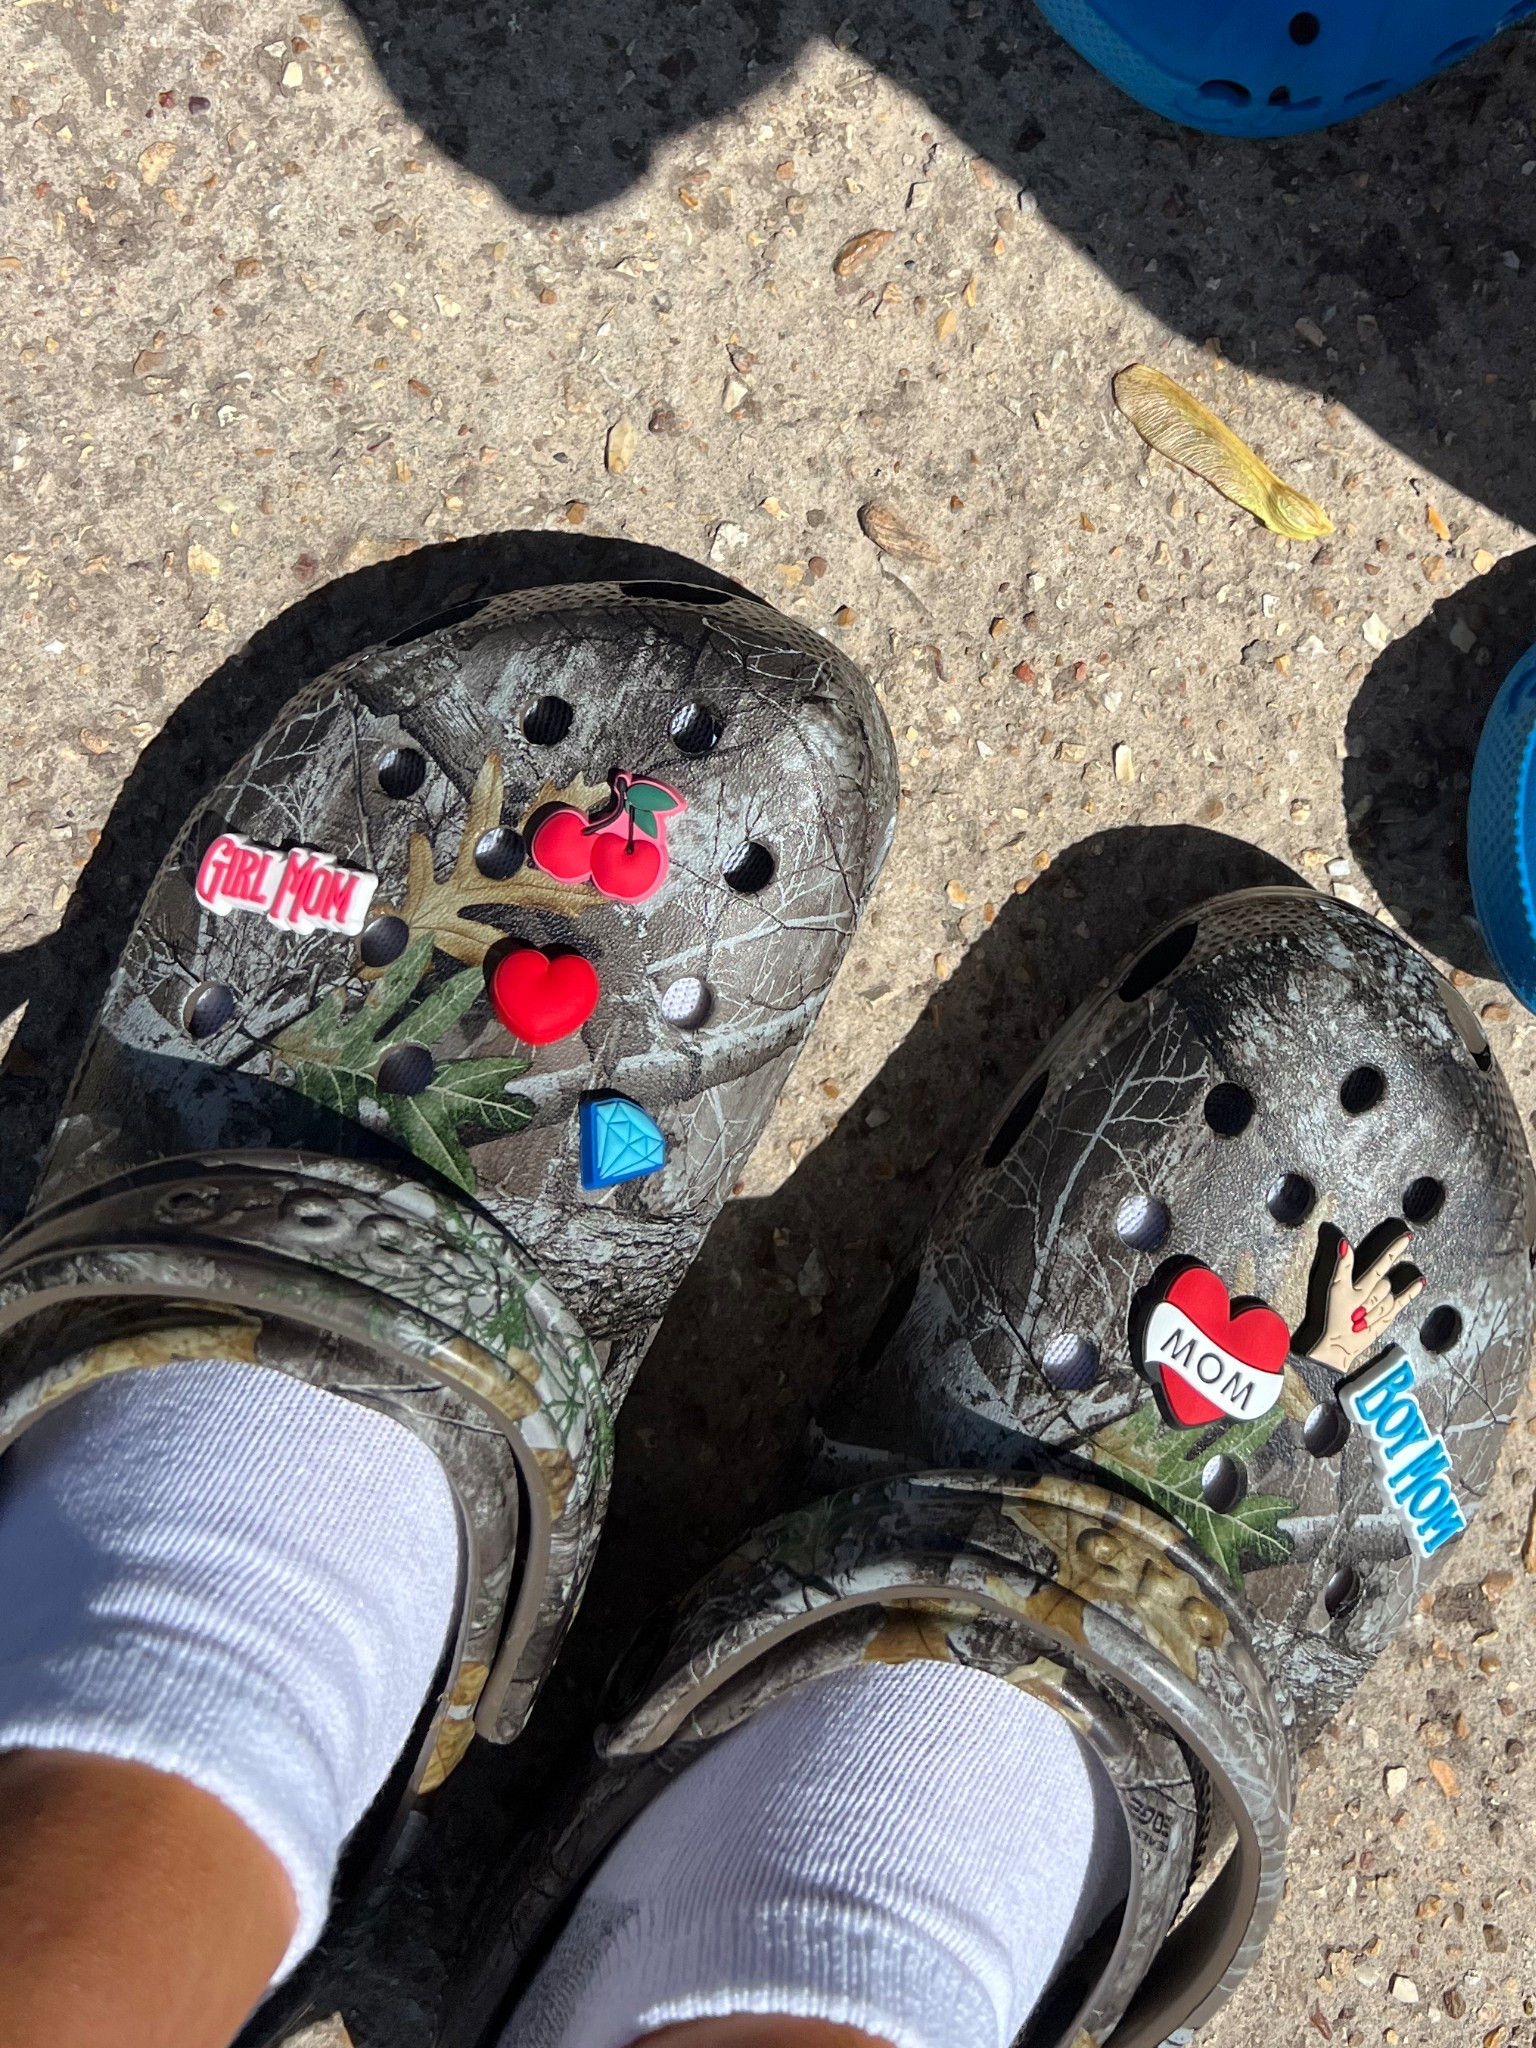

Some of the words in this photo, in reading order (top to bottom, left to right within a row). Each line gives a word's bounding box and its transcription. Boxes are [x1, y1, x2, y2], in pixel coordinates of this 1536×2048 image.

[197, 837, 274, 904] GIRL
[270, 850, 360, 924] MOM
[1160, 1327, 1256, 1411] MOM
[1354, 1359, 1430, 1460] BOY
[1387, 1438, 1465, 1553] MOM
